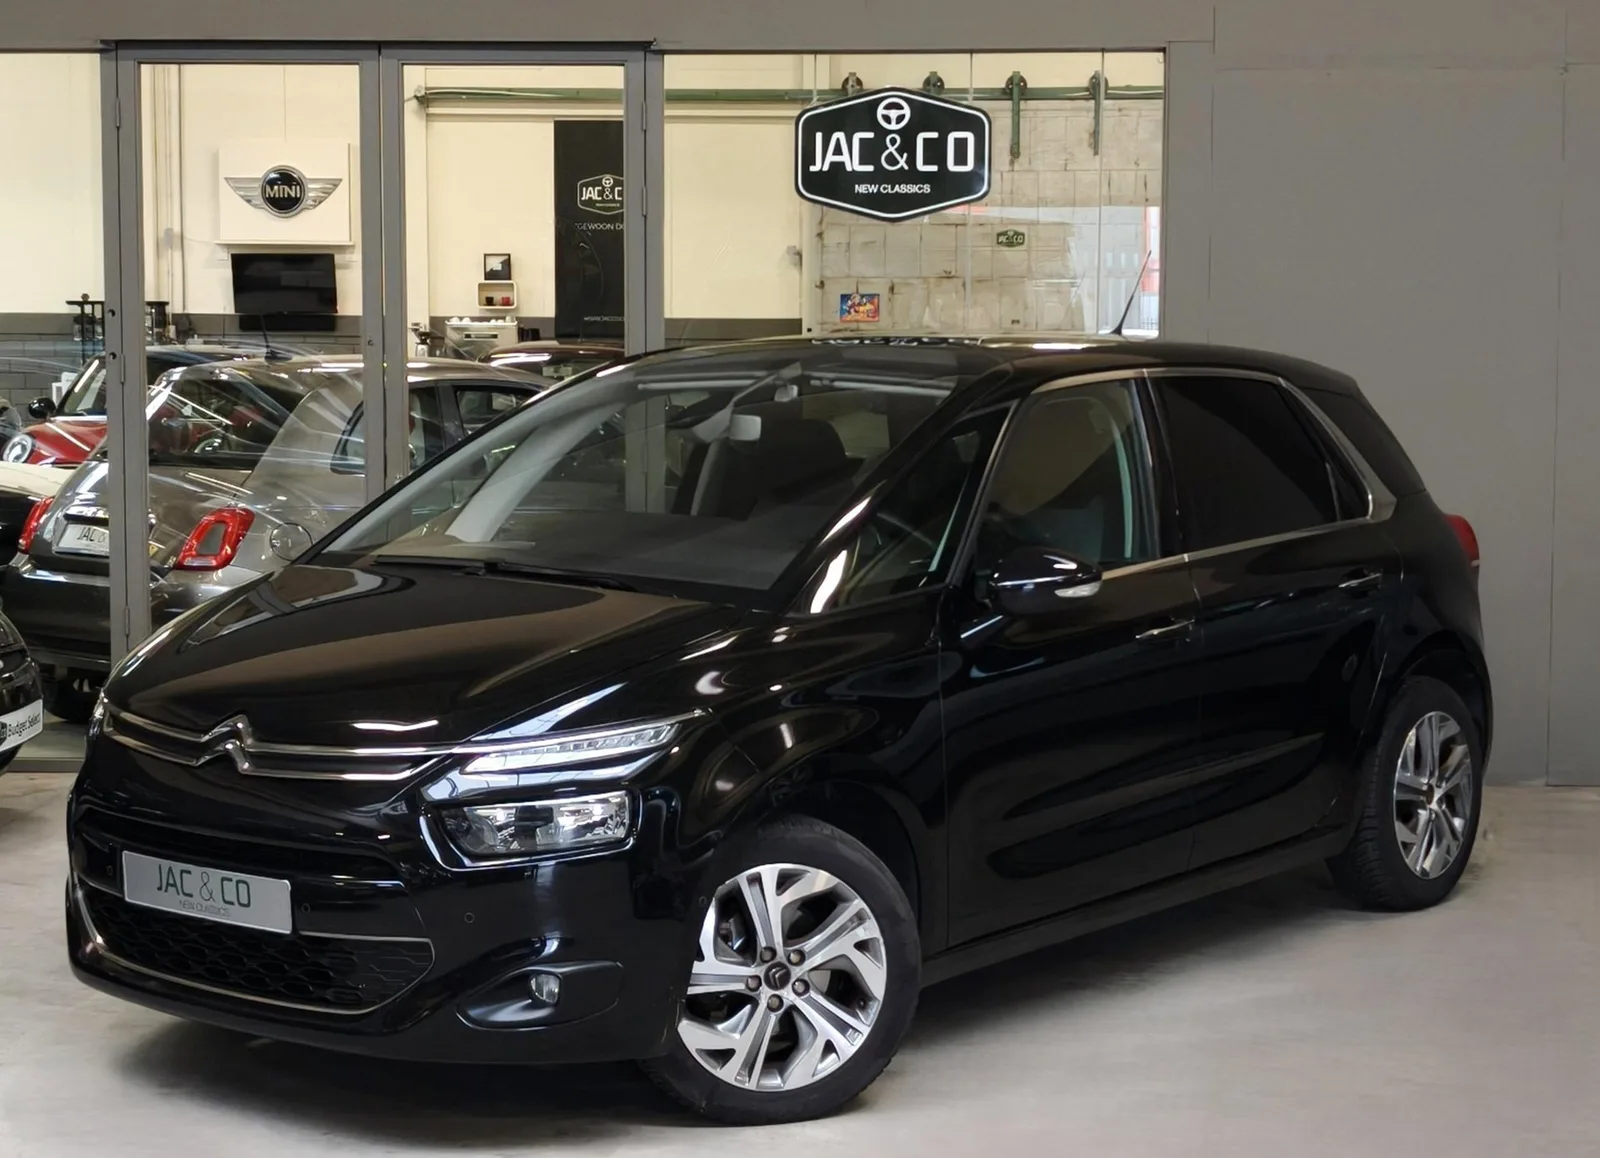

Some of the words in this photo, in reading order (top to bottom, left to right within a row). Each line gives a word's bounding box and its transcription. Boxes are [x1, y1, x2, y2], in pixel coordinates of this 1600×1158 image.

[809, 131, 875, 172] JAC
[880, 133, 909, 171] &
[916, 131, 975, 172] CO
[265, 185, 301, 198] MINI
[581, 187, 602, 200] JAC
[603, 187, 613, 200] &
[854, 184, 878, 194] NEW
[880, 184, 931, 194] CLASSICS
[157, 863, 194, 898] JAC
[199, 871, 216, 903] &
[220, 876, 251, 908] CO
